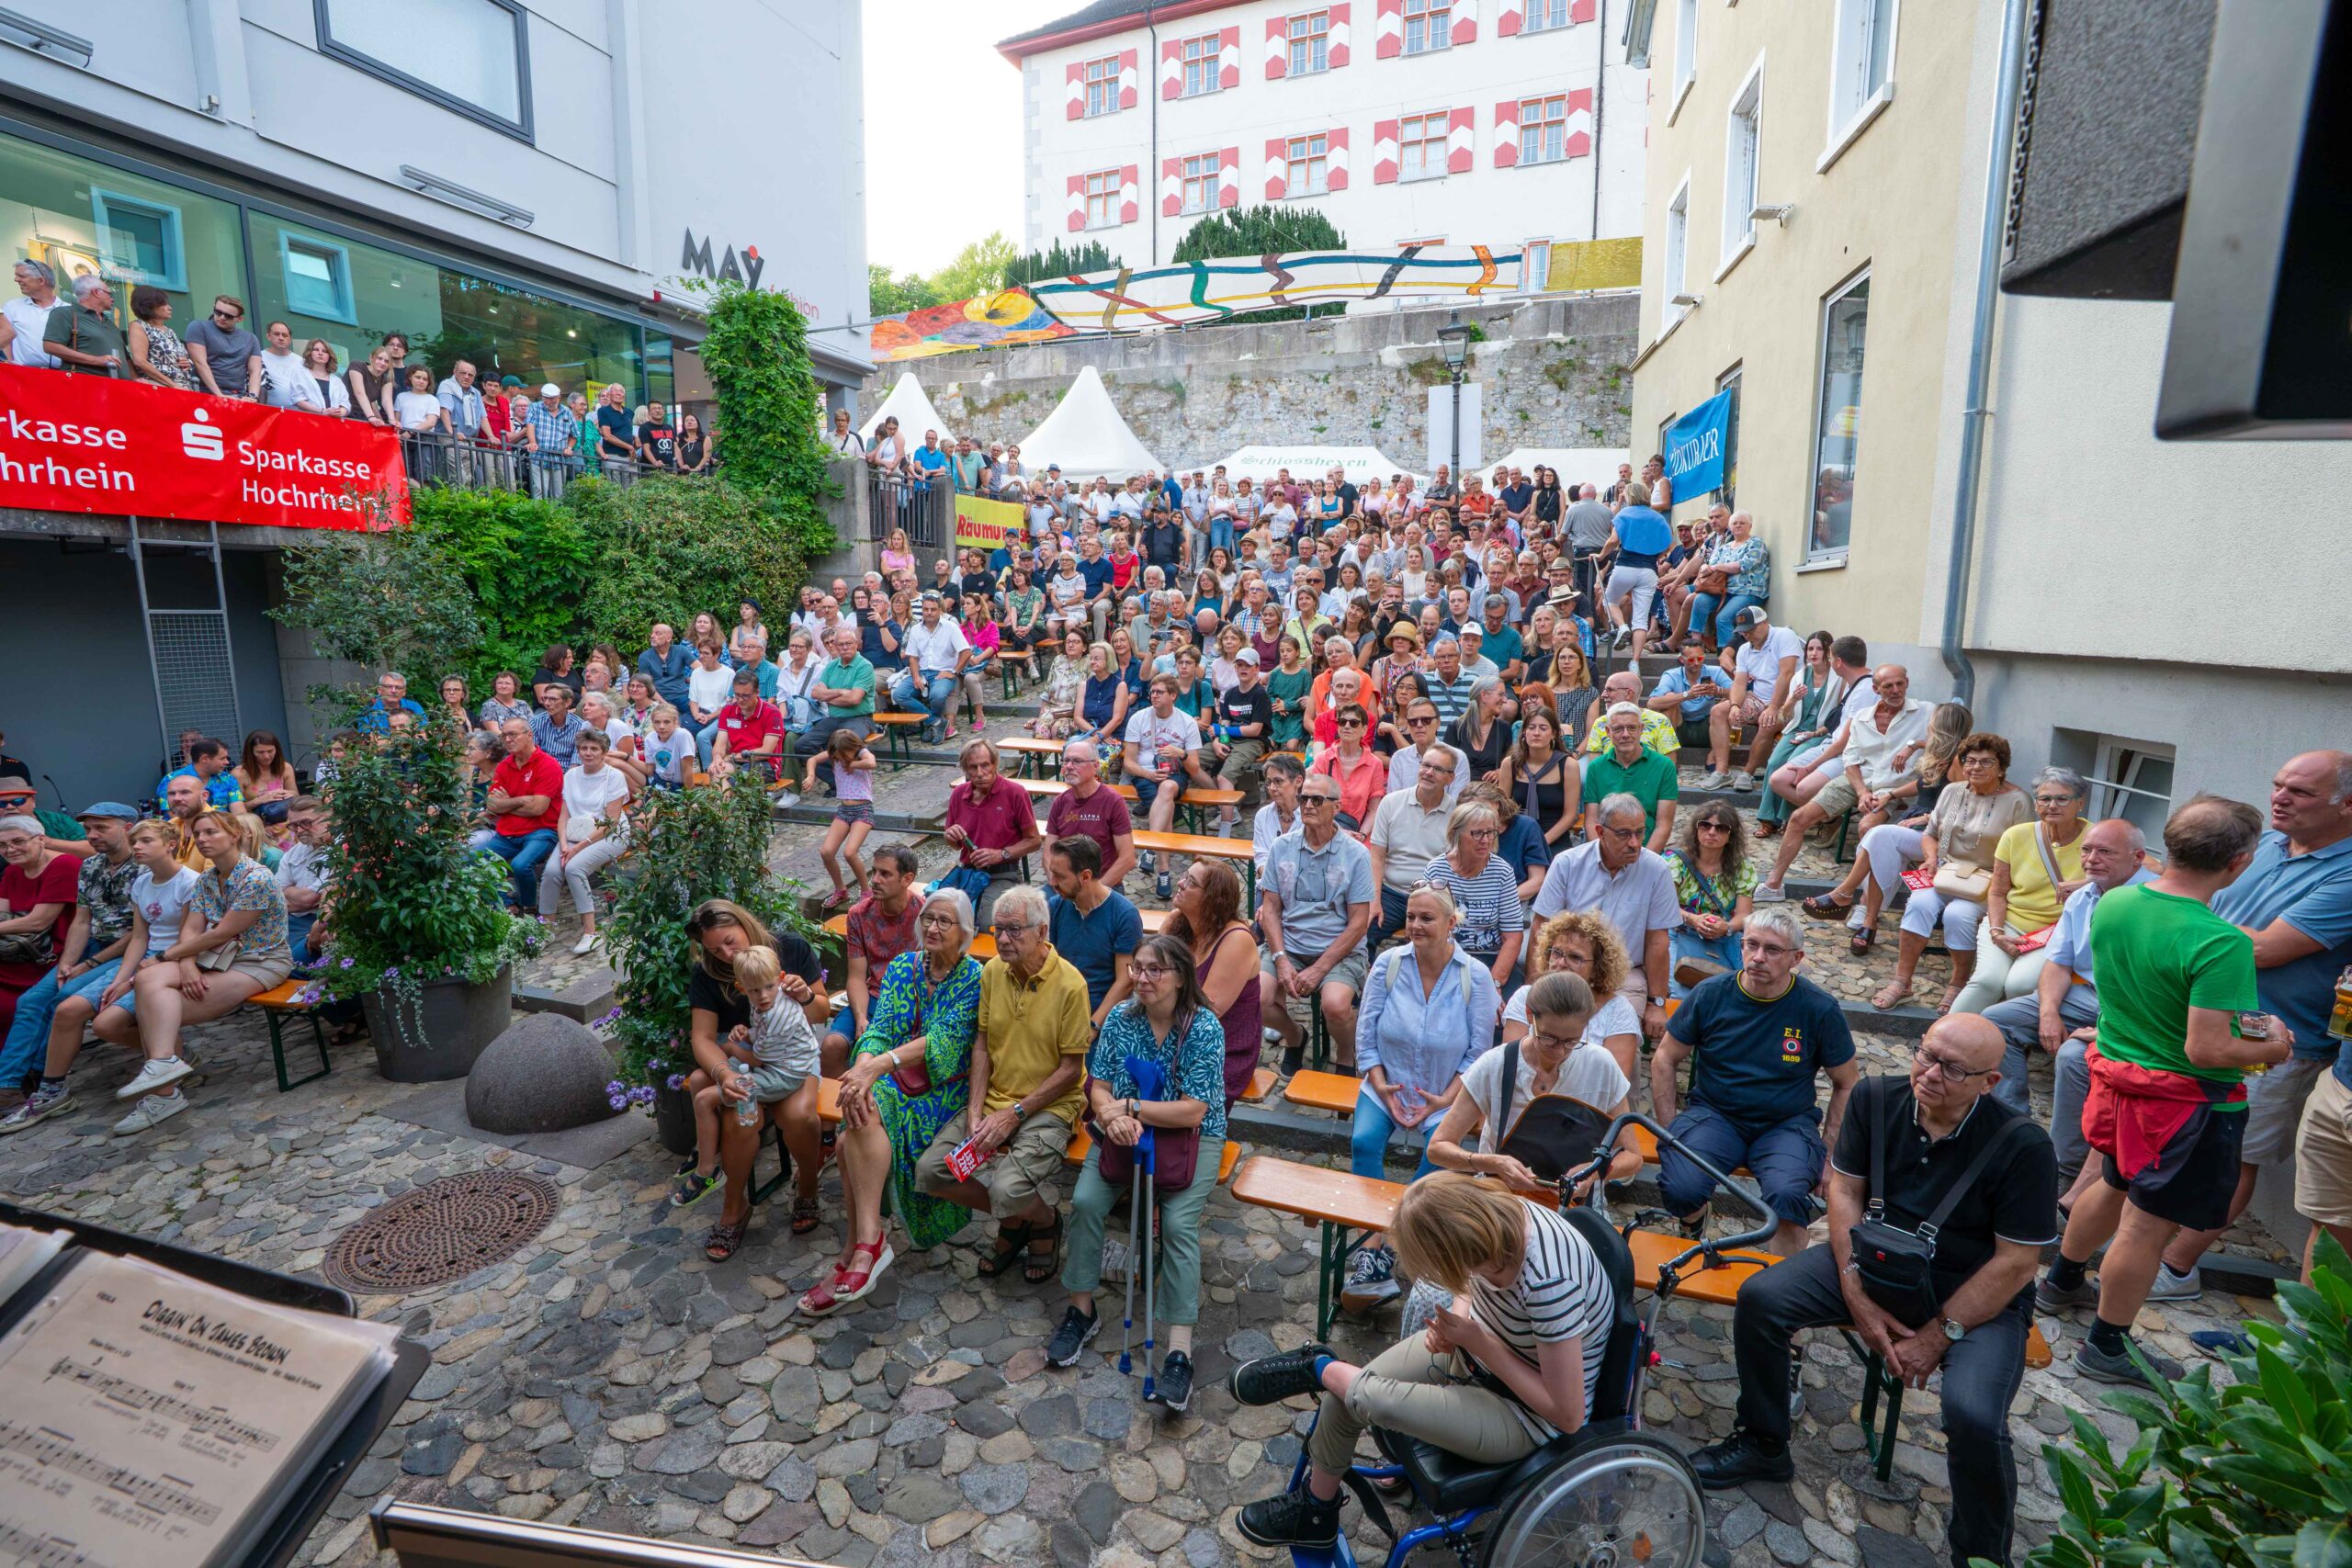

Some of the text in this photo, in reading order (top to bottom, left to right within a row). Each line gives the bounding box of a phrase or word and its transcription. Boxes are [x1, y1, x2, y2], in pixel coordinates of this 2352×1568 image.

[682, 226, 765, 291] MAY
[237, 441, 370, 480] Sparkasse
[957, 1155, 971, 1177] JAZZ
[963, 1149, 978, 1171] FEST
